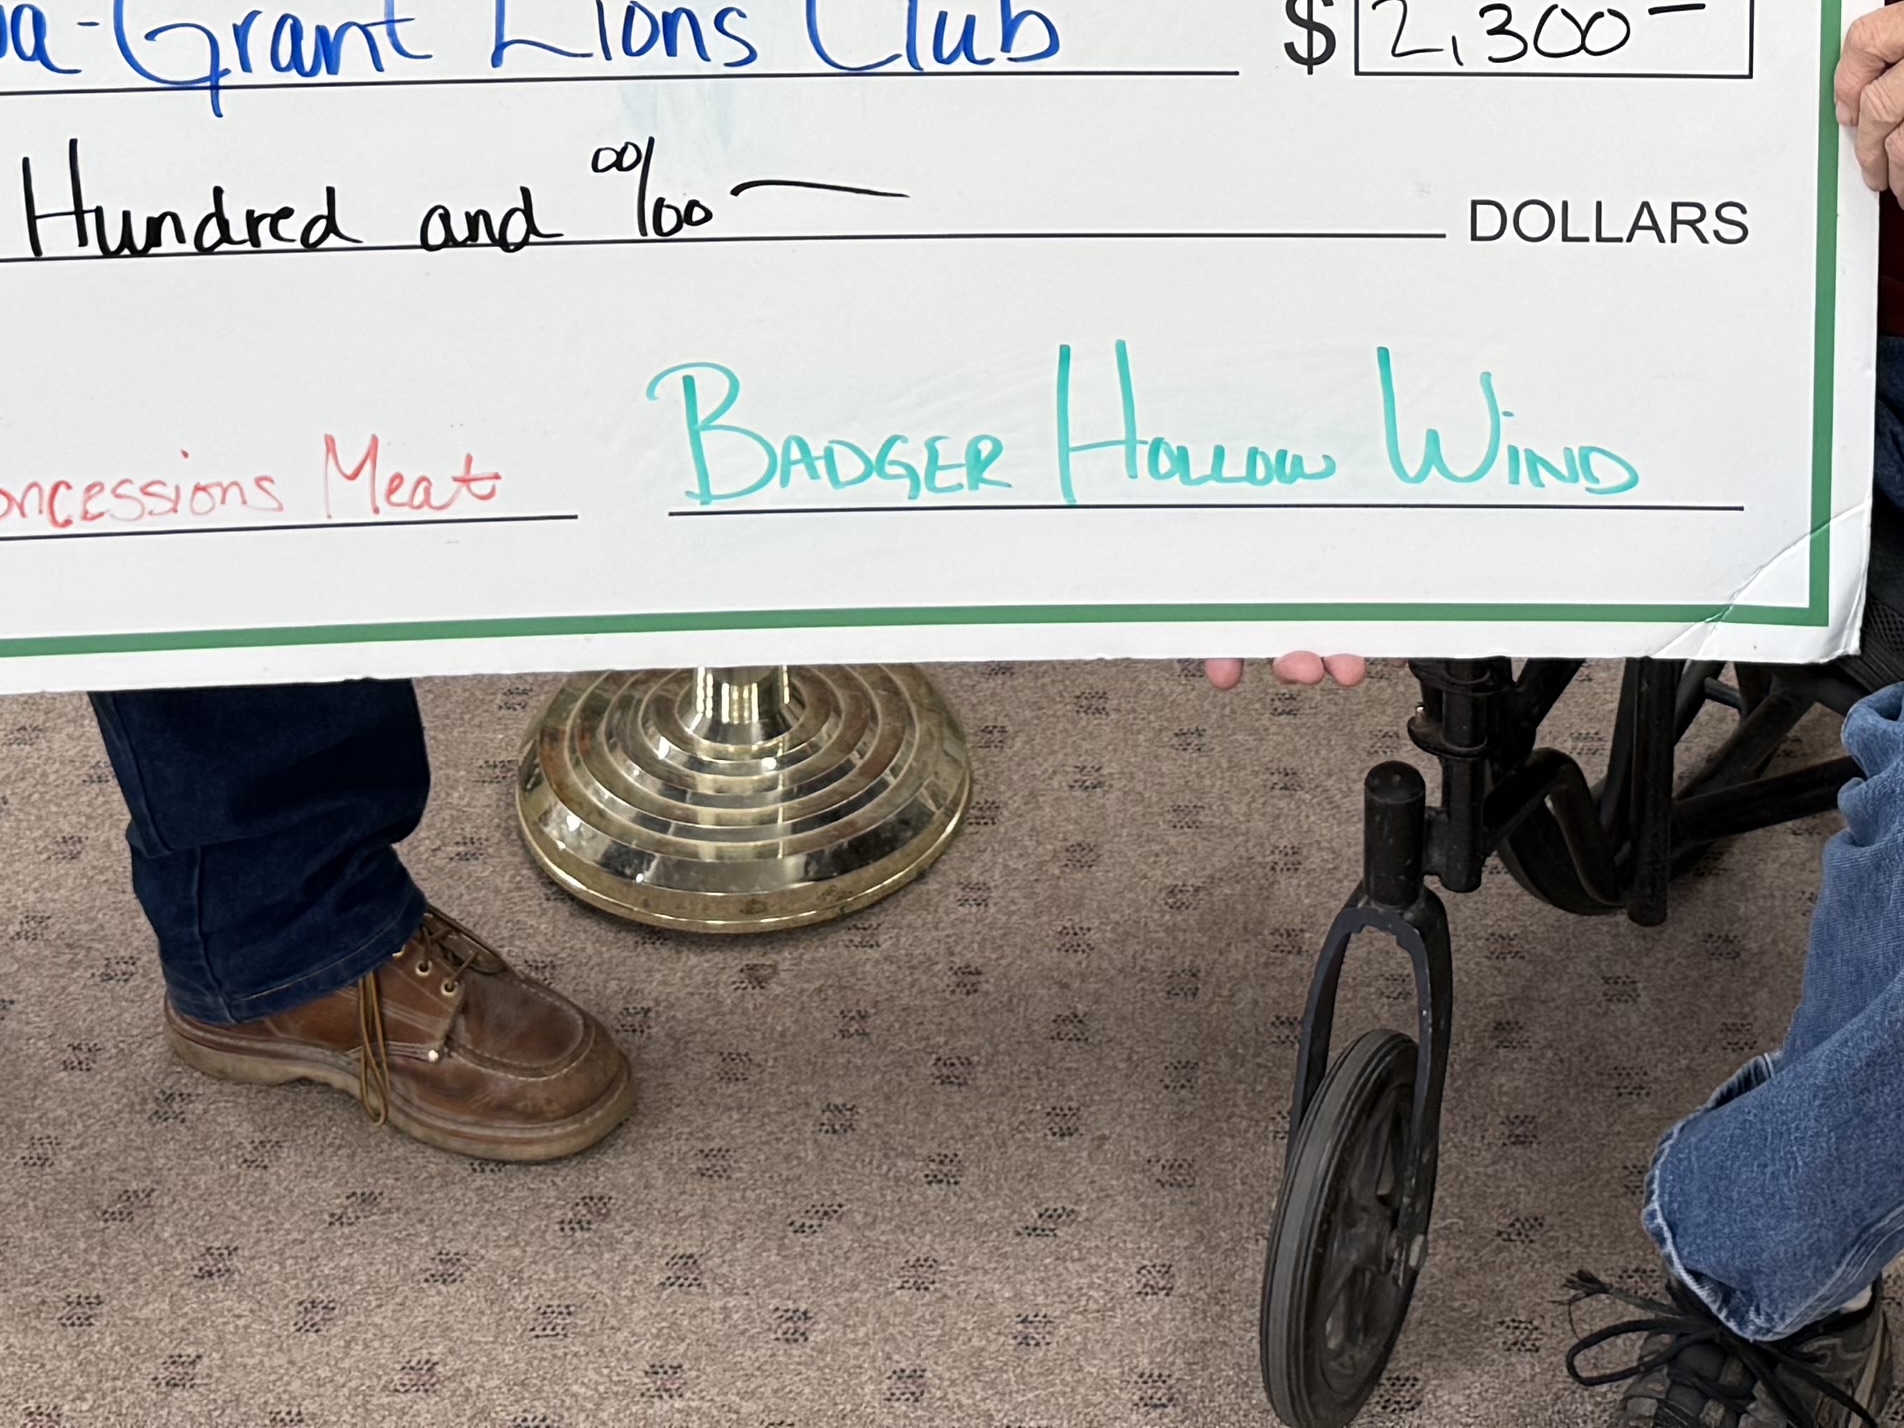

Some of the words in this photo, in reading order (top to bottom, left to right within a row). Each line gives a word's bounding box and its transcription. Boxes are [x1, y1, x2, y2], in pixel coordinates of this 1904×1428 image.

[22, 138, 359, 261] Hundred
[419, 186, 562, 255] and
[1469, 199, 1750, 248] DOLLARS
[321, 433, 503, 520] Meat
